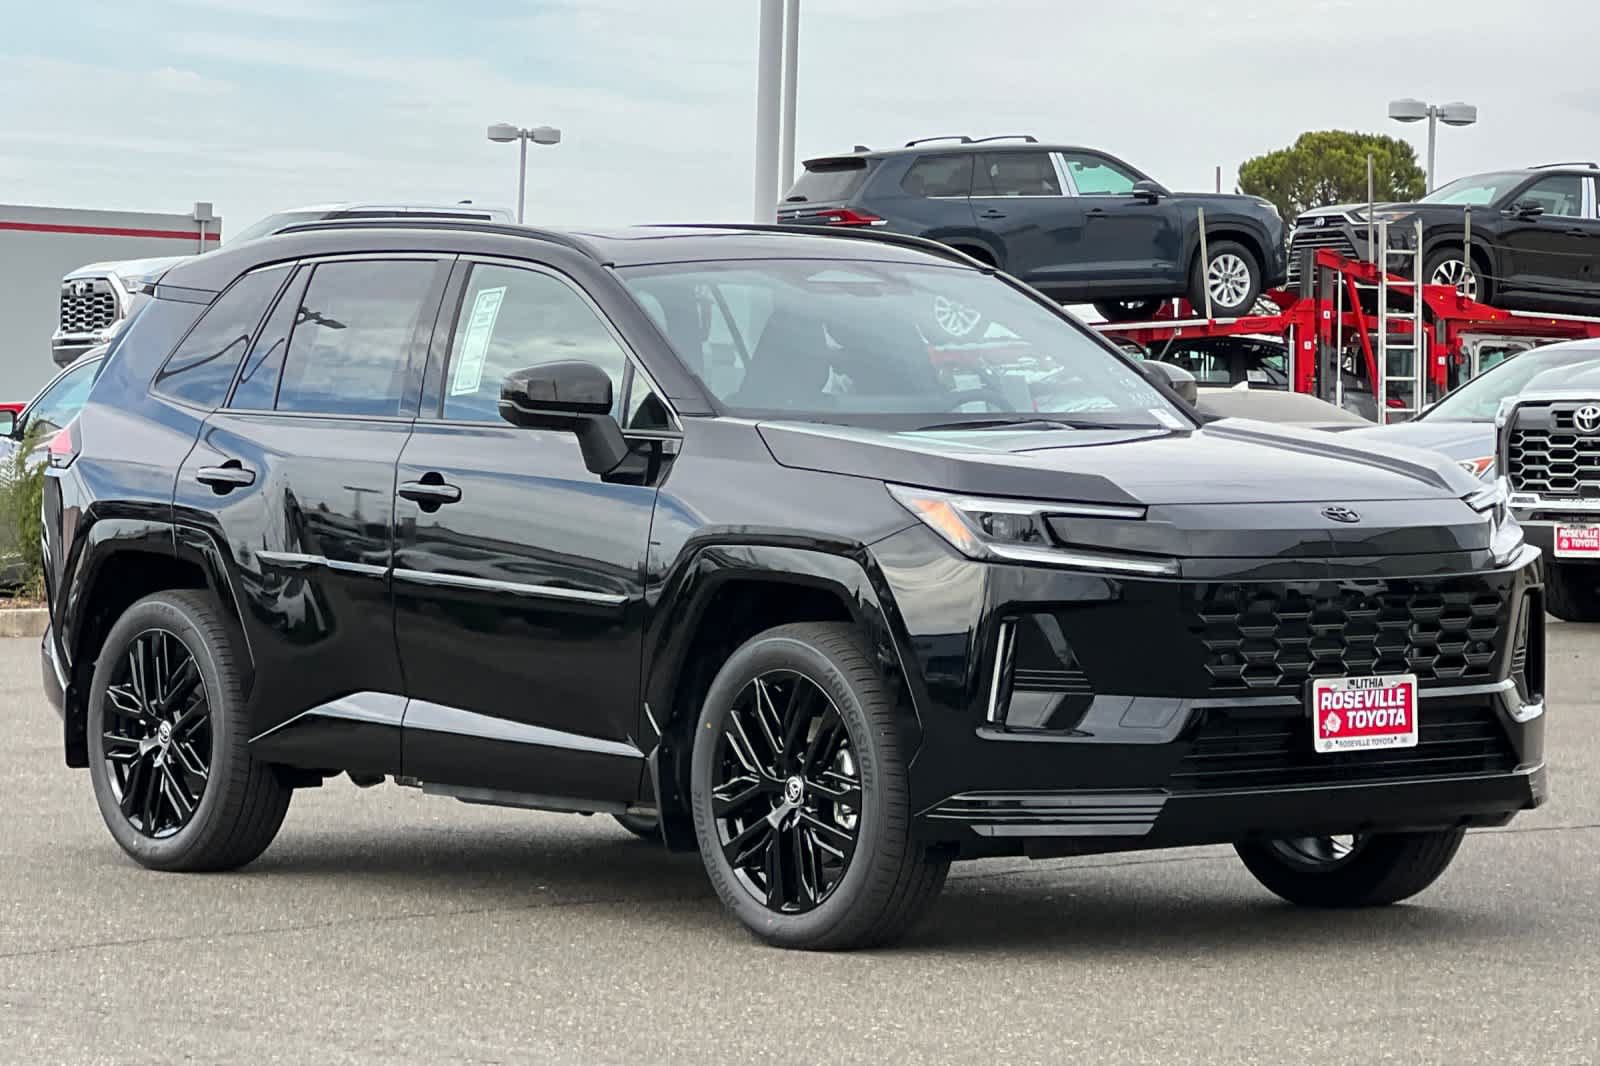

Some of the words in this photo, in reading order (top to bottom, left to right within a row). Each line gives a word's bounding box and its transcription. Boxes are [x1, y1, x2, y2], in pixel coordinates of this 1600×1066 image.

[1560, 528, 1598, 538] ROSEVILLE
[1571, 538, 1598, 548] TOYOTA
[1356, 678, 1384, 689] LITHIA
[1321, 688, 1405, 710] ROSEVILLE
[1347, 709, 1406, 728] TOYOTA
